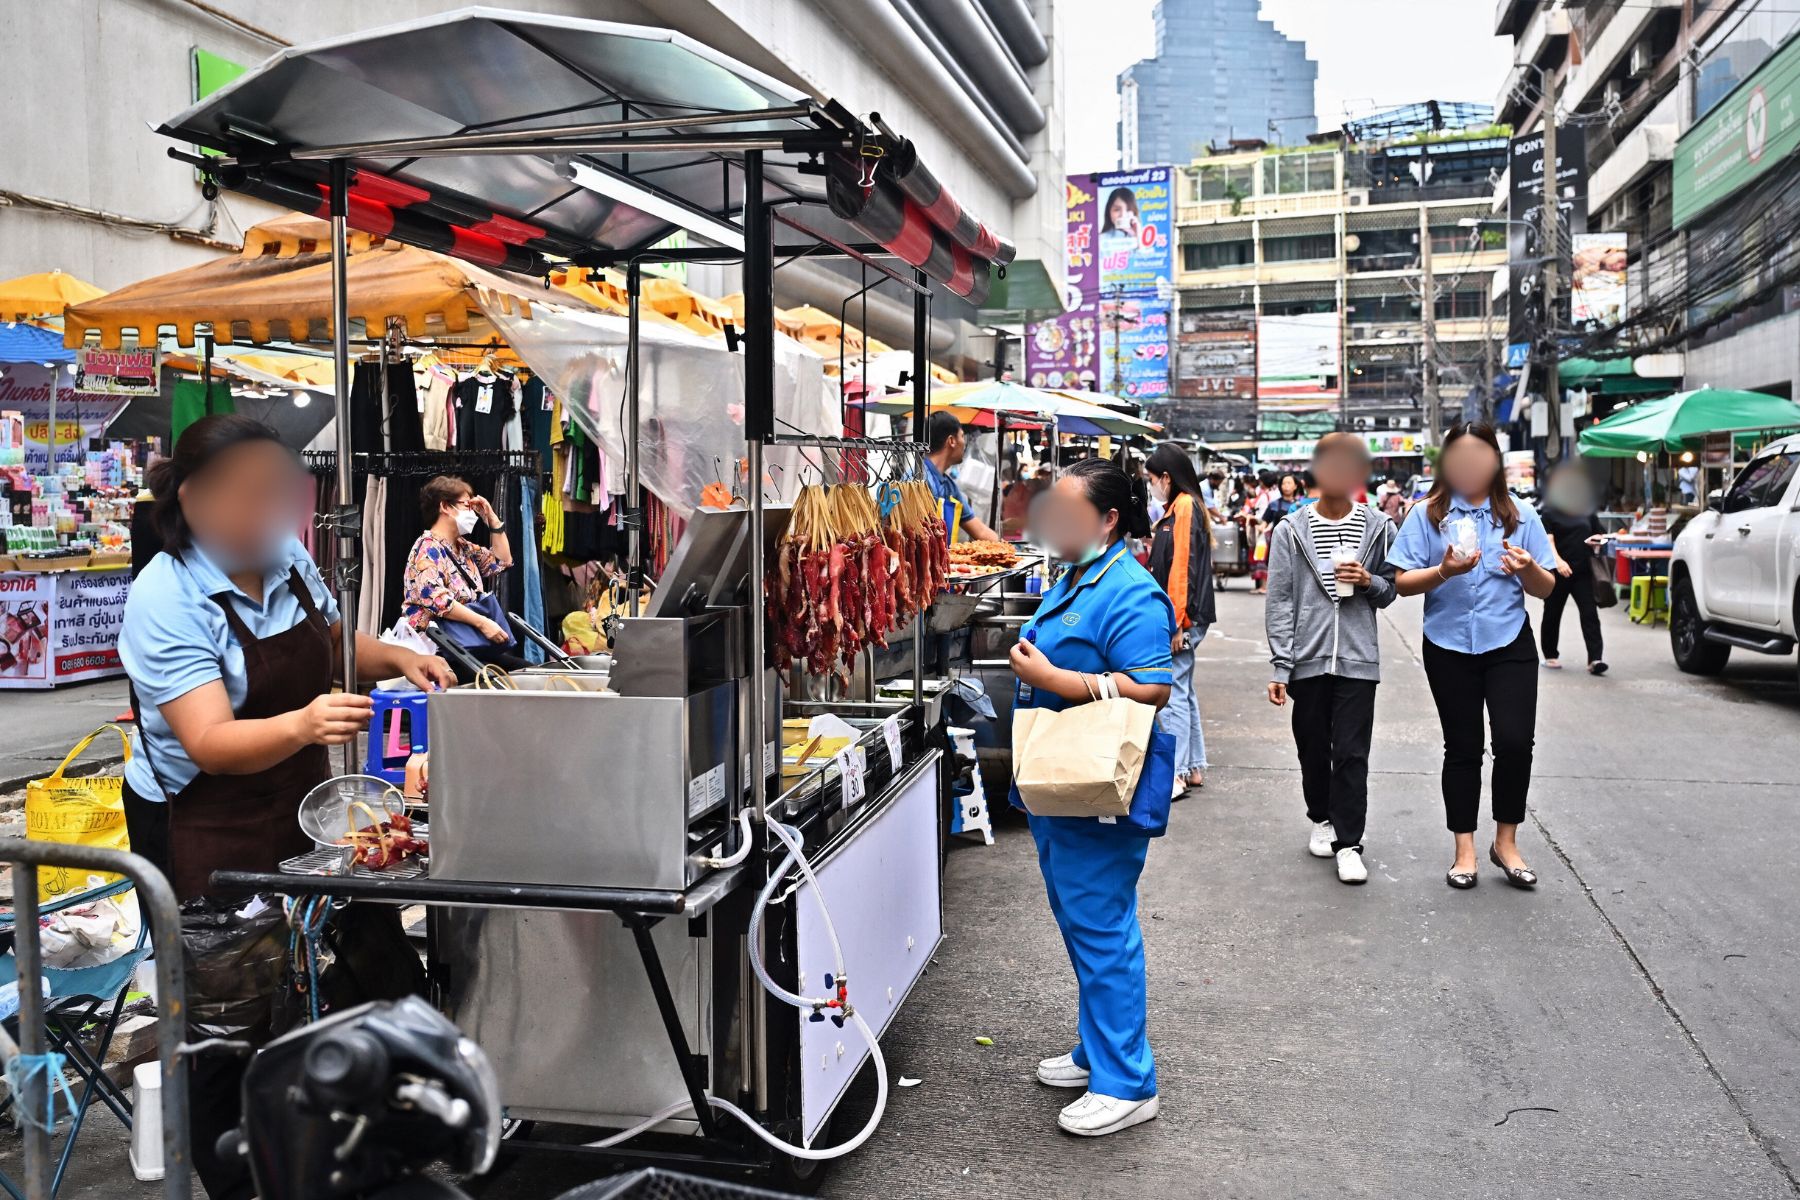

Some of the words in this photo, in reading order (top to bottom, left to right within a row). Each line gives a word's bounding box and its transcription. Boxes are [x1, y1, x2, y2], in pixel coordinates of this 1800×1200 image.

[1515, 139, 1545, 155] SONY
[1151, 170, 1166, 182] 23
[1198, 378, 1235, 391] JVC
[29, 423, 80, 440] ปลี-ส่ง
